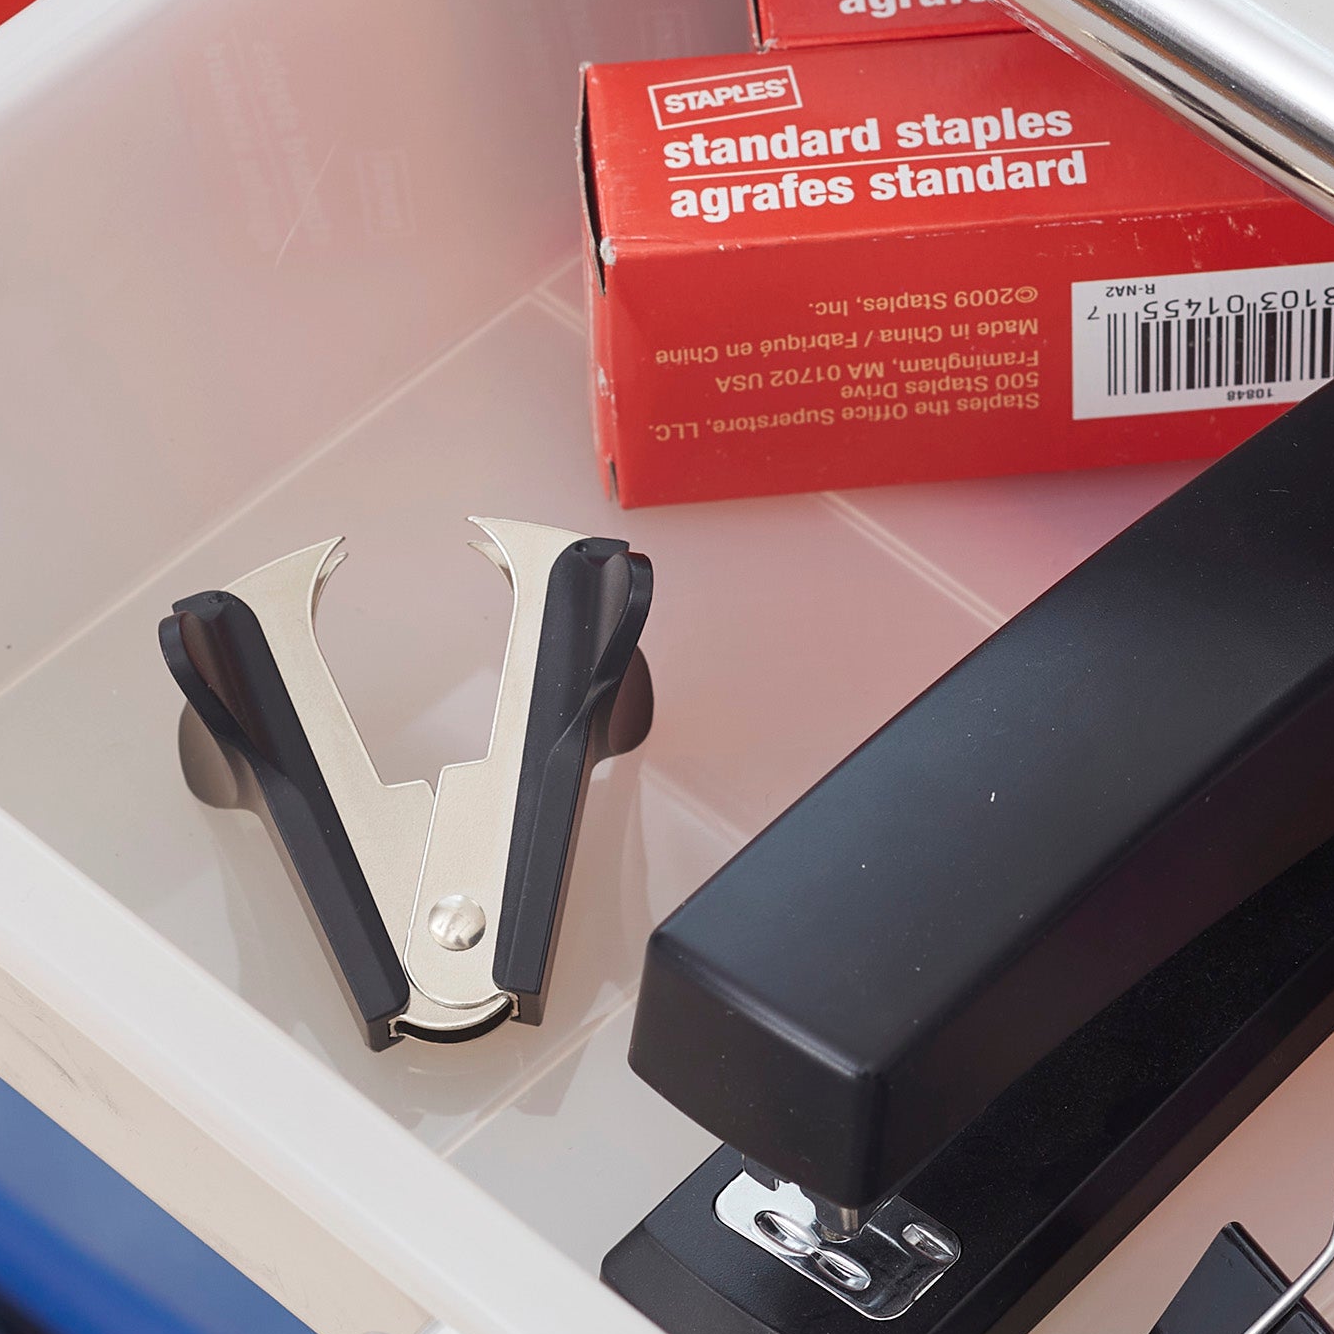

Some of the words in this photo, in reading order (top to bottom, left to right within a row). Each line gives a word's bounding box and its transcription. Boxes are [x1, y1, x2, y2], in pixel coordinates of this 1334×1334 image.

[664, 79, 786, 115] STAPLES
[663, 118, 880, 169] standard
[896, 107, 1073, 150] staples
[670, 172, 855, 223] agrafes
[869, 151, 1087, 201] standard
[809, 300, 848, 317] Inc.
[856, 292, 947, 313] Staples,
[880, 325, 942, 344] China
[950, 323, 969, 340] in
[977, 318, 1038, 338] Made
[726, 342, 753, 357] en
[760, 332, 858, 357] Fabriqué
[655, 346, 718, 365] Chine
[893, 350, 1039, 373] Framingham,
[769, 365, 841, 387] 01702
[847, 362, 884, 380] MA
[996, 371, 1039, 390] 500
[715, 373, 763, 393] USA
[841, 382, 898, 400] Drive
[905, 375, 988, 395] Staples
[915, 400, 949, 416] the
[957, 393, 1039, 412] Staples
[706, 408, 835, 433] Superstore,
[841, 403, 908, 422] Office
[648, 422, 699, 441] LLC.
